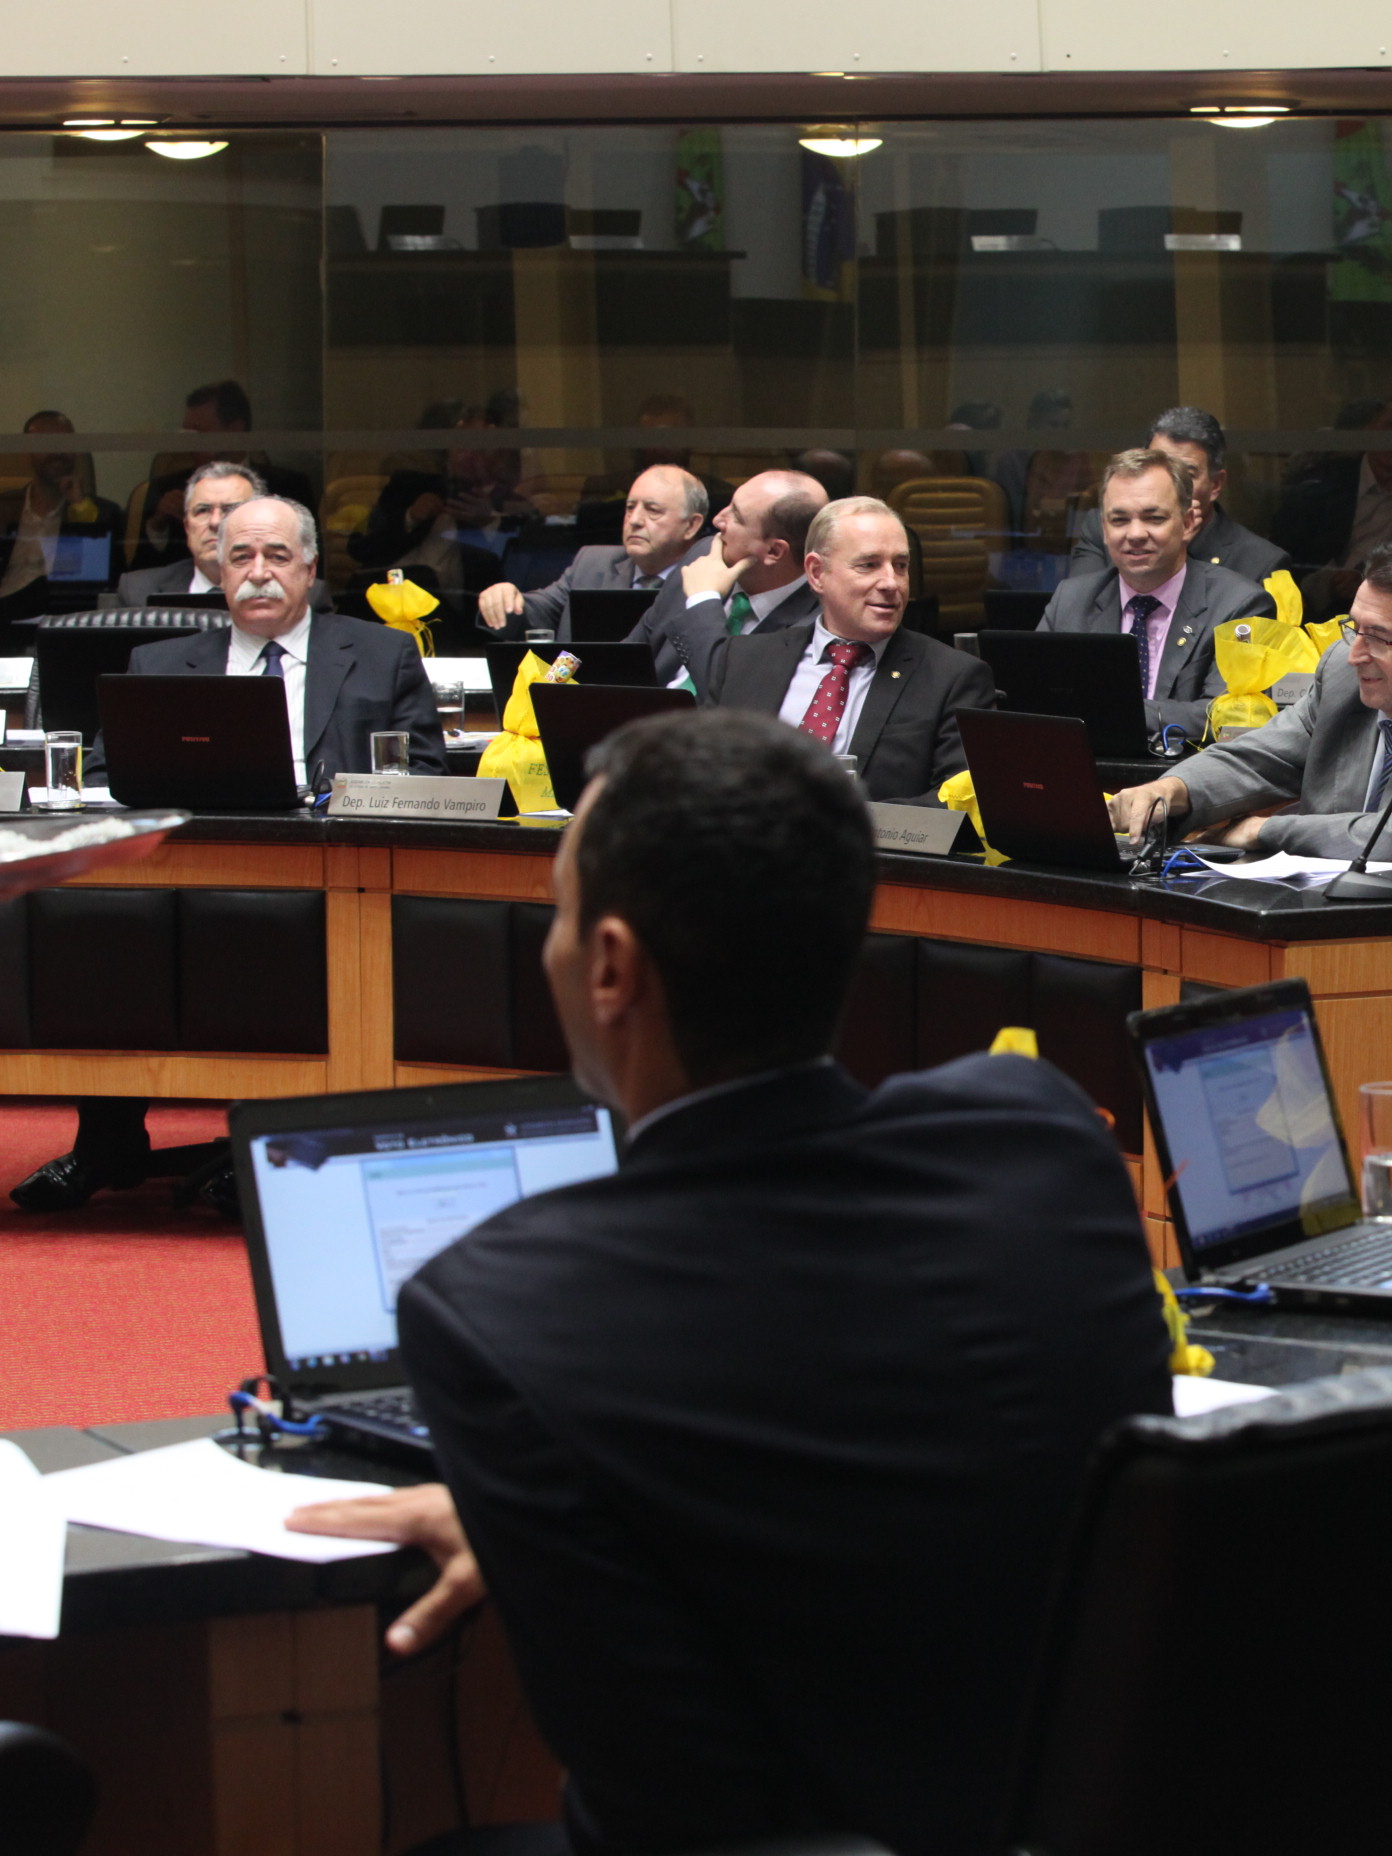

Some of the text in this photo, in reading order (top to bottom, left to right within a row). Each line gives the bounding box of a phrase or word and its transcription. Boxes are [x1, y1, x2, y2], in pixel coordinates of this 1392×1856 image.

[342, 795, 487, 814] Dep. Luiz Fernando Vampiro
[899, 829, 929, 845] Aguiar
